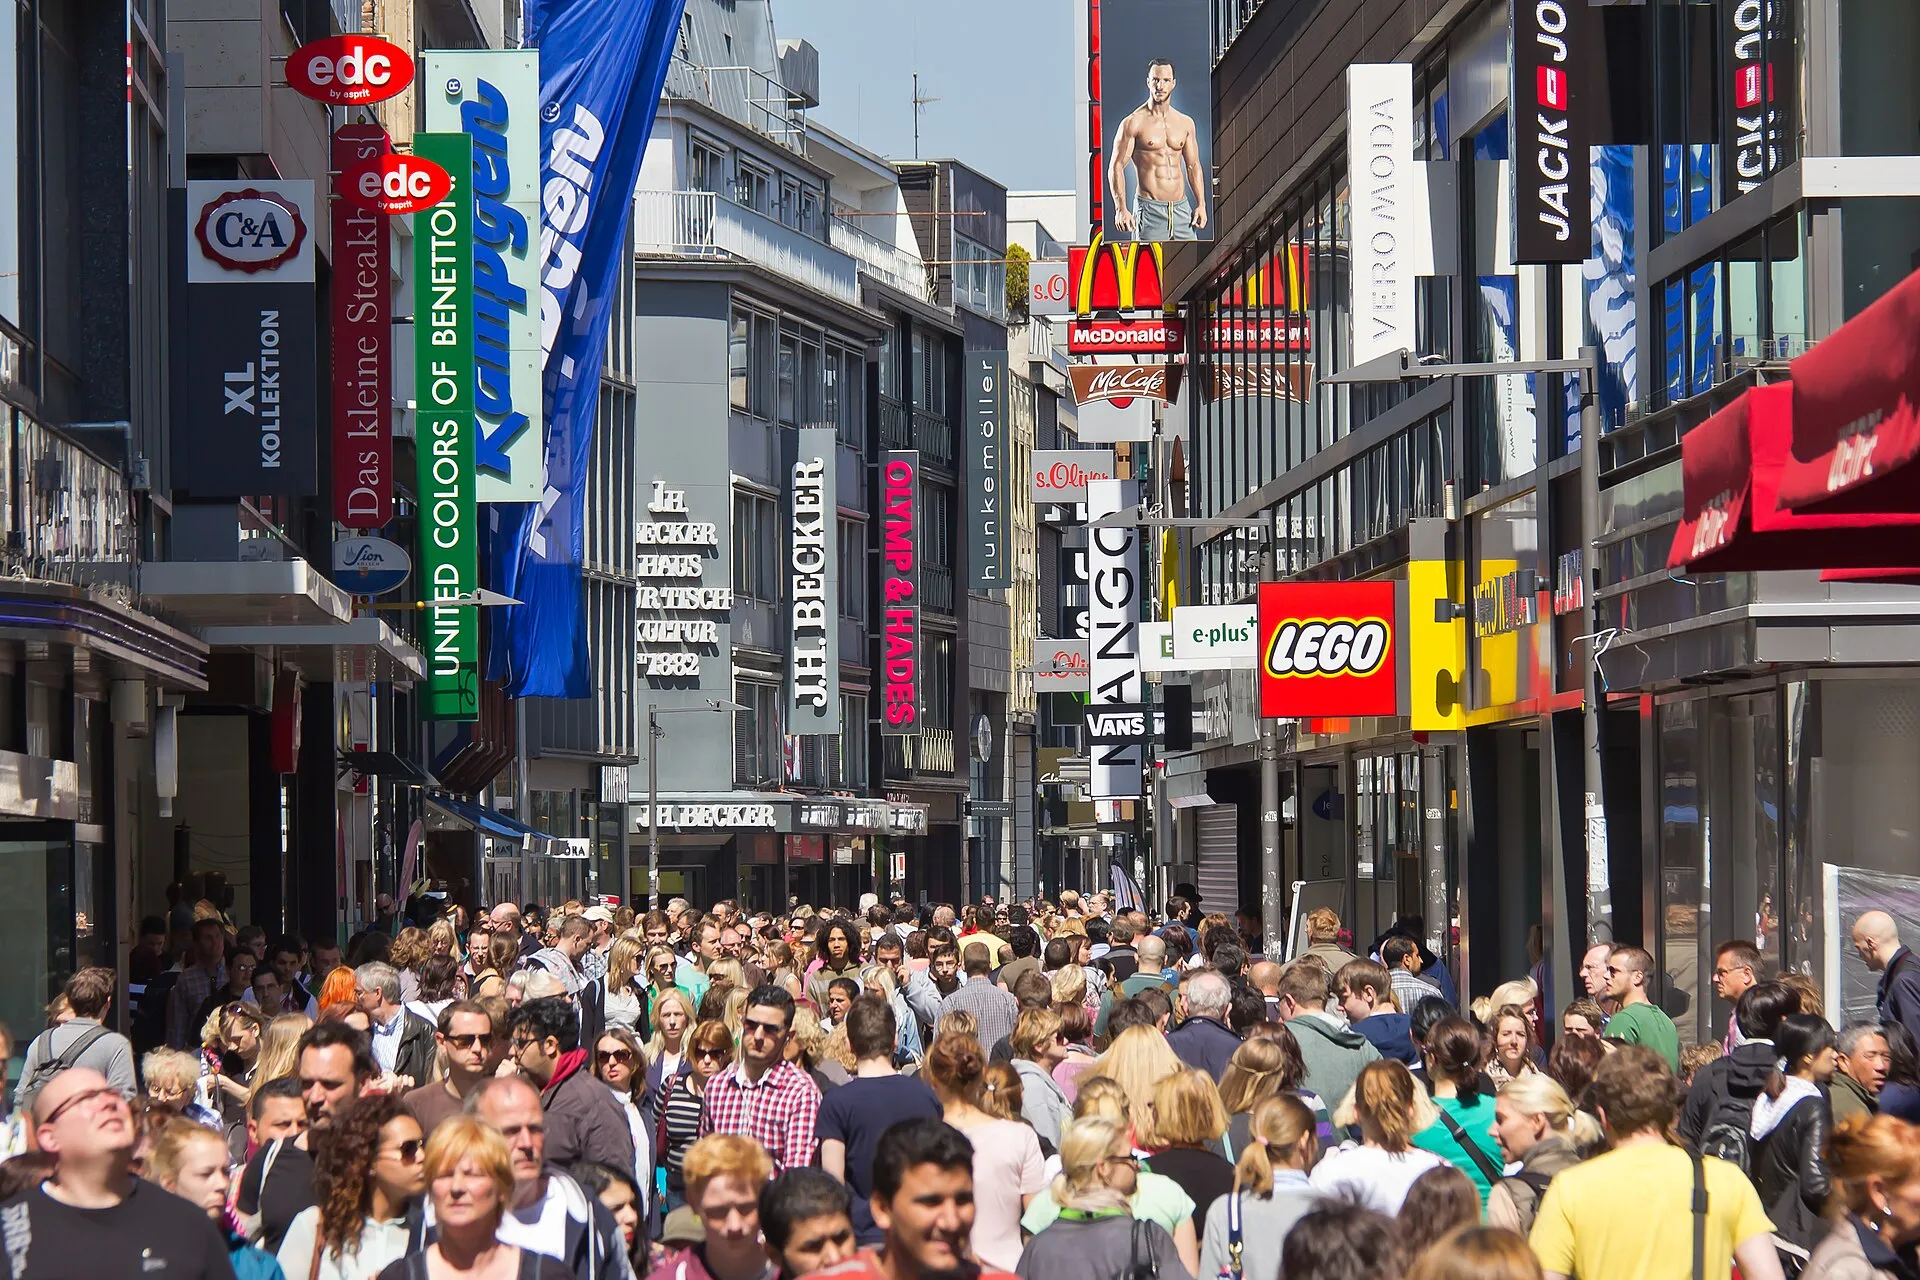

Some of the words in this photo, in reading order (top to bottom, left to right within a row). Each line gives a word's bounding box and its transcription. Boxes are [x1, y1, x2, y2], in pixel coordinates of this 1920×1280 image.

[307, 46, 392, 86] edc
[329, 89, 341, 98] by
[343, 88, 370, 98] esprit
[358, 164, 431, 198] edc
[1369, 97, 1396, 221] MODA
[1537, 113, 1570, 241] JACK
[215, 211, 287, 248] C&A
[377, 201, 388, 210] by
[389, 200, 413, 209] esprit
[346, 146, 378, 323] Steakhs
[1371, 231, 1397, 340] VERO
[1073, 328, 1178, 344] McDonald's
[224, 362, 255, 415] XL
[260, 310, 281, 468] KOLLEKTION
[347, 336, 379, 439] kleine
[431, 361, 458, 406] OF
[1089, 367, 1166, 395] McCafé
[347, 451, 379, 519] Das
[432, 419, 460, 549] COLORS
[978, 360, 996, 580] hunkemöller
[885, 460, 913, 573] OLYMP
[637, 554, 703, 578] HAUS
[885, 577, 914, 602] &
[433, 563, 460, 676] UNITED
[660, 586, 733, 610] TISCH
[646, 652, 700, 676] 1882
[885, 608, 915, 725] HADES
[1271, 623, 1385, 673] LEGO
[1086, 712, 1146, 737] VANS
